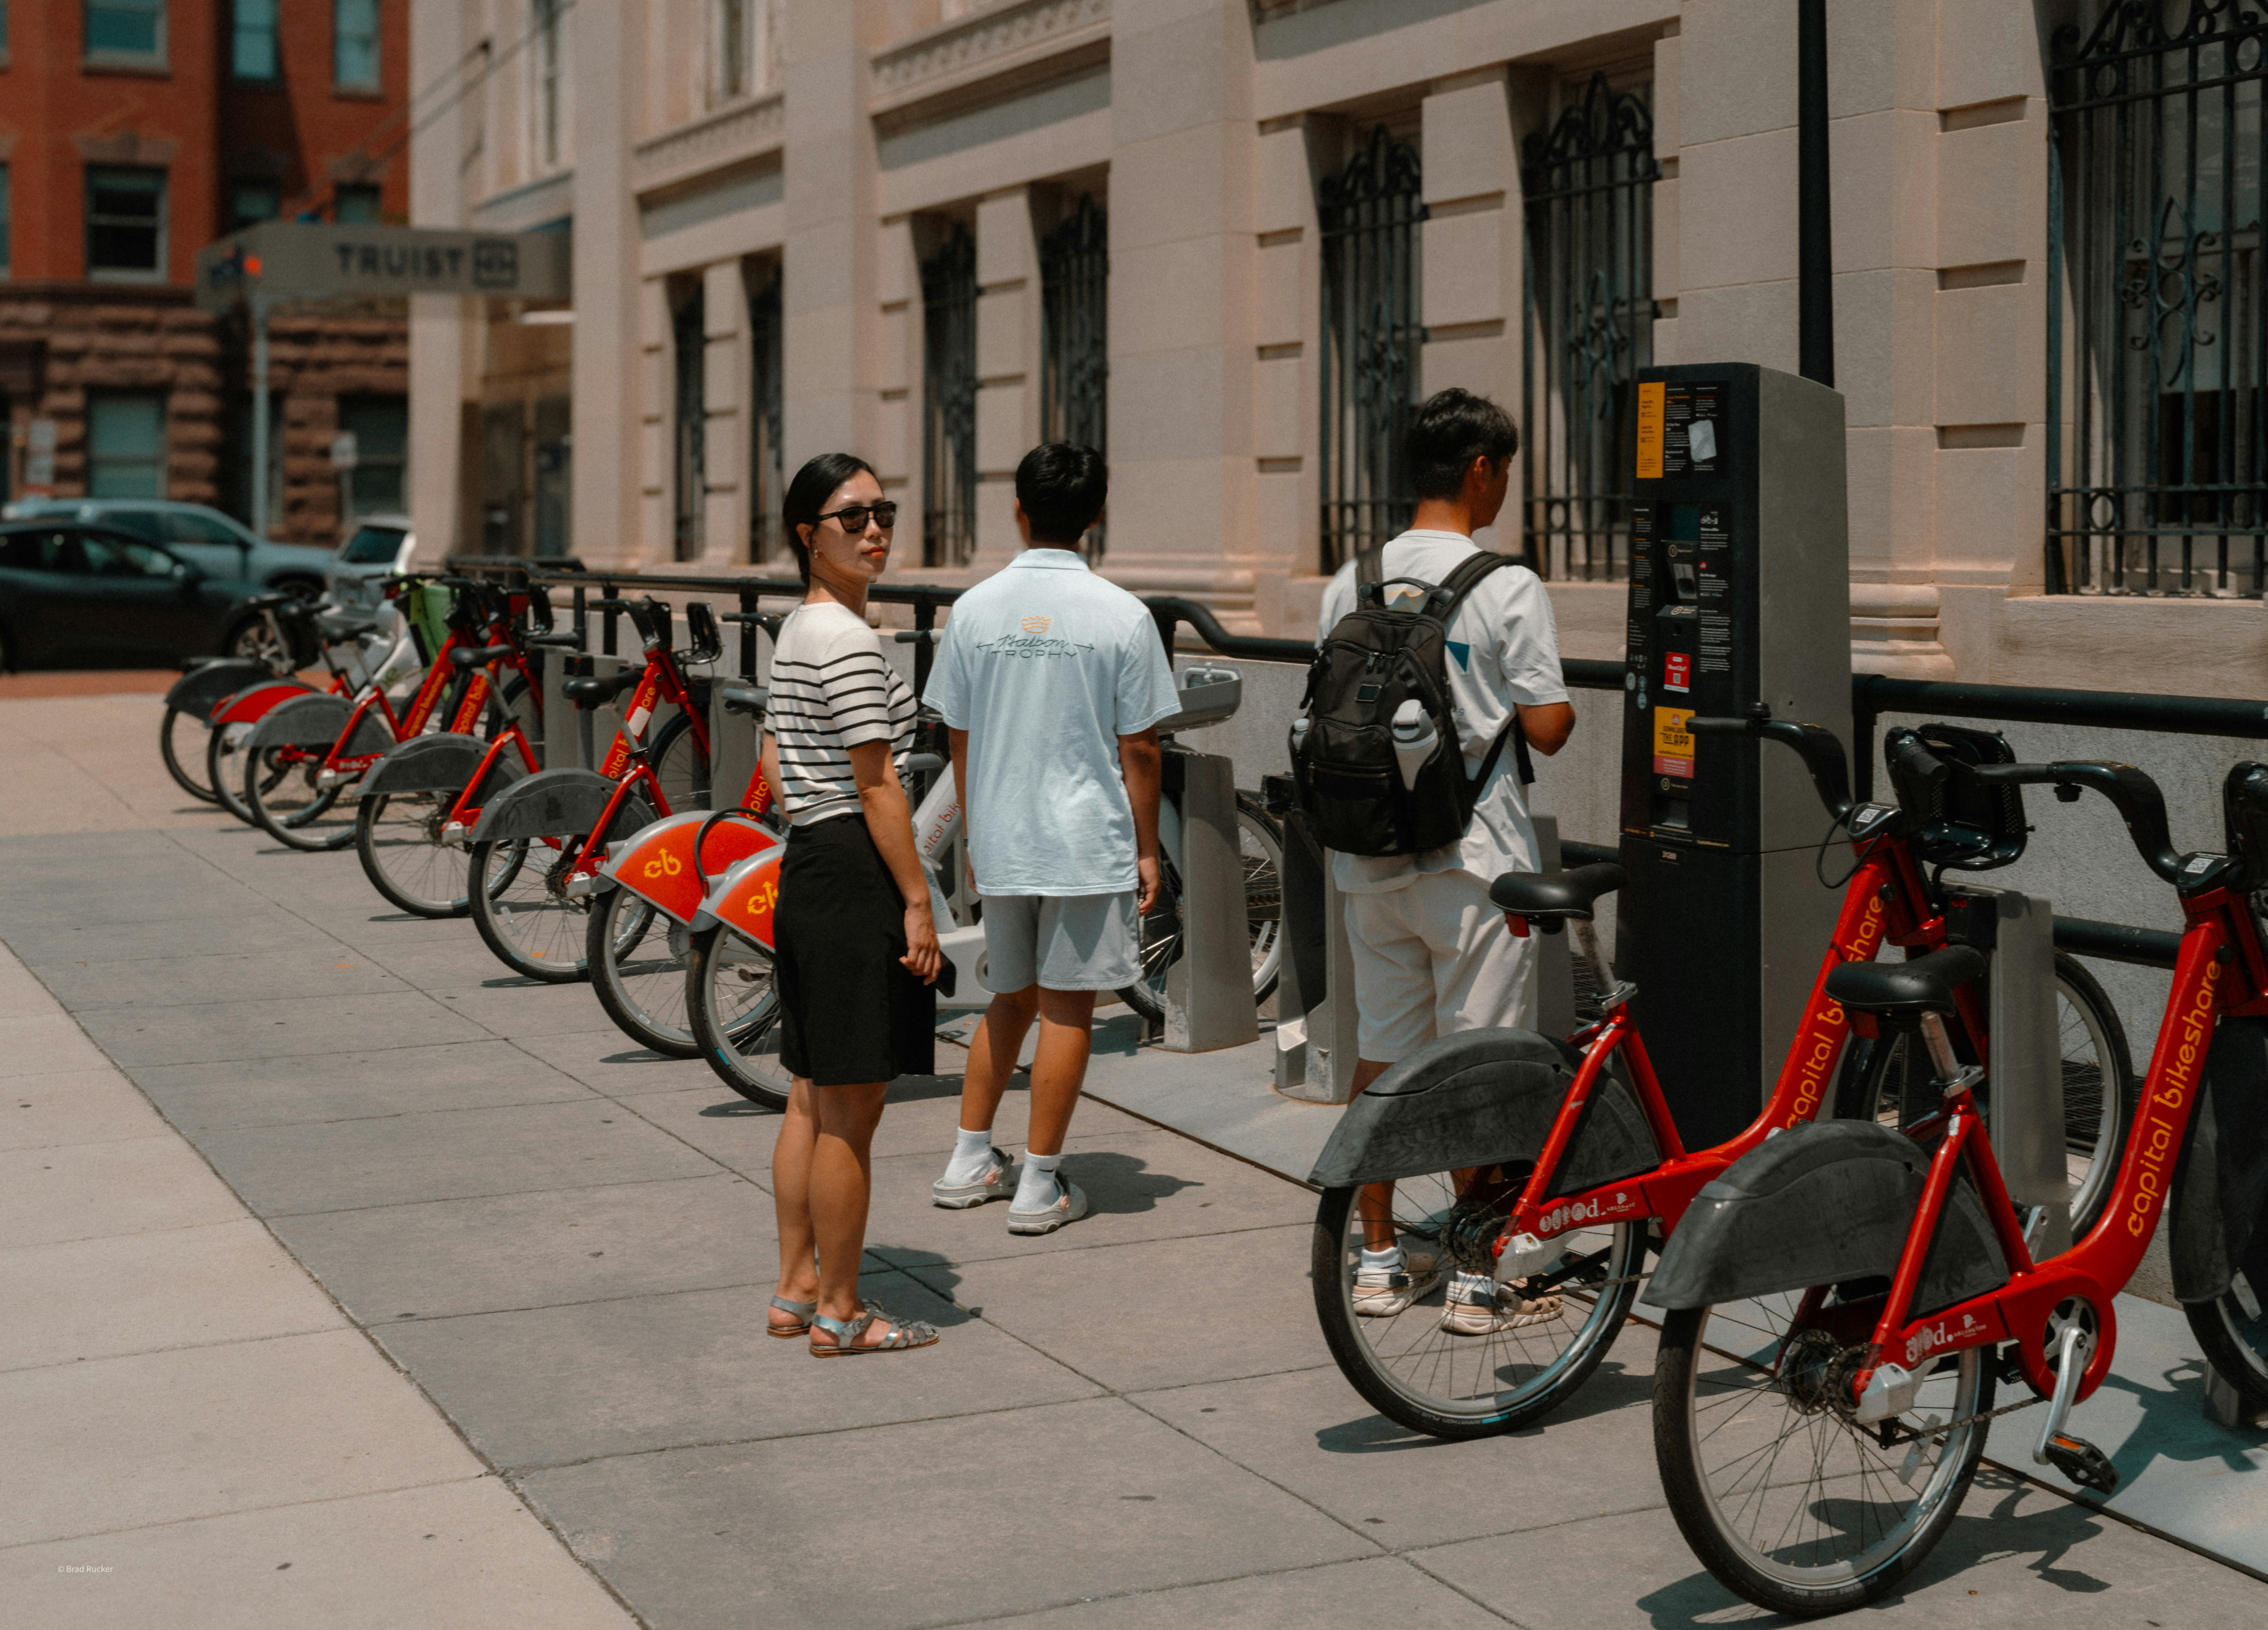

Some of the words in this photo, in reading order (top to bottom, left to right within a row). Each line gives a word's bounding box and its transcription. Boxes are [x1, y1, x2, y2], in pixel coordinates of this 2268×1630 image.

[335, 242, 464, 276] TRUIST
[991, 649, 1077, 660] TROPHY
[1816, 896, 1883, 1026] bishare
[2127, 1117, 2173, 1238] capital
[2152, 961, 2221, 1109] bikeshare
